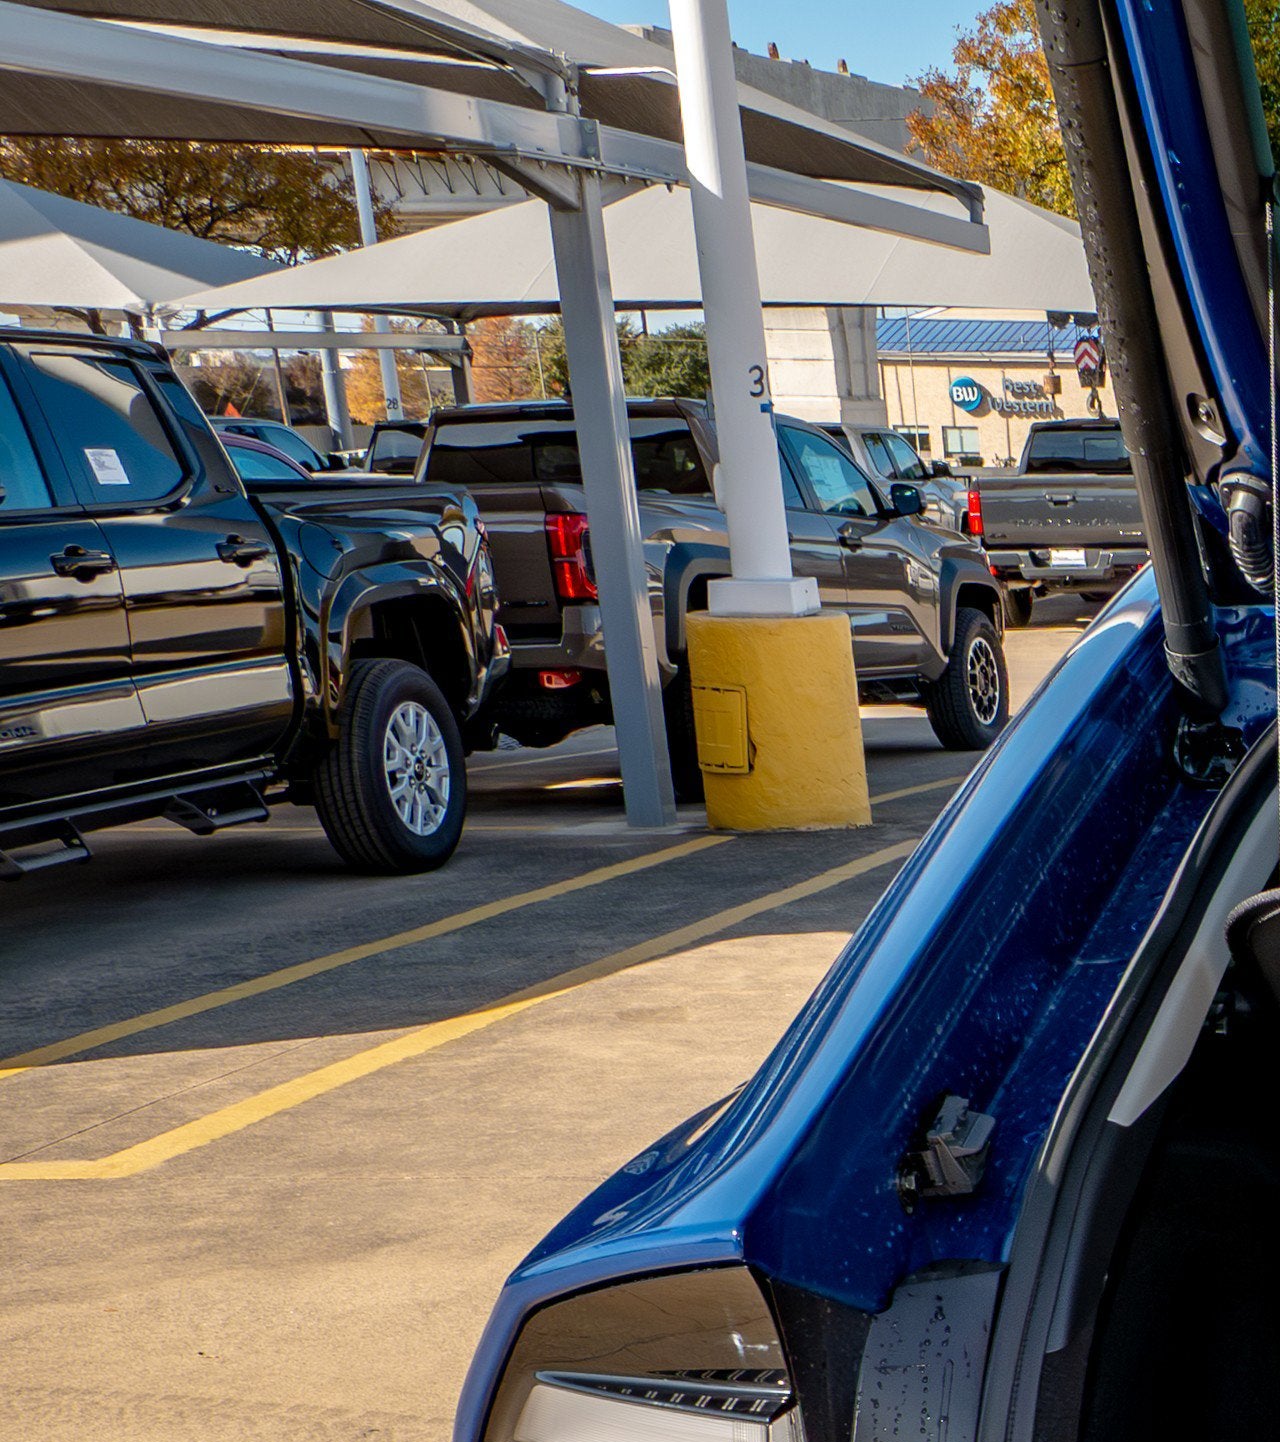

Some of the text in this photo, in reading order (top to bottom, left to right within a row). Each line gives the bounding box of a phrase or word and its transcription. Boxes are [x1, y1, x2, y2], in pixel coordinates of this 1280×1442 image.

[748, 364, 765, 398] 3
[1001, 377, 1038, 394] Best
[952, 386, 978, 402] BW
[987, 396, 1055, 413] Western
